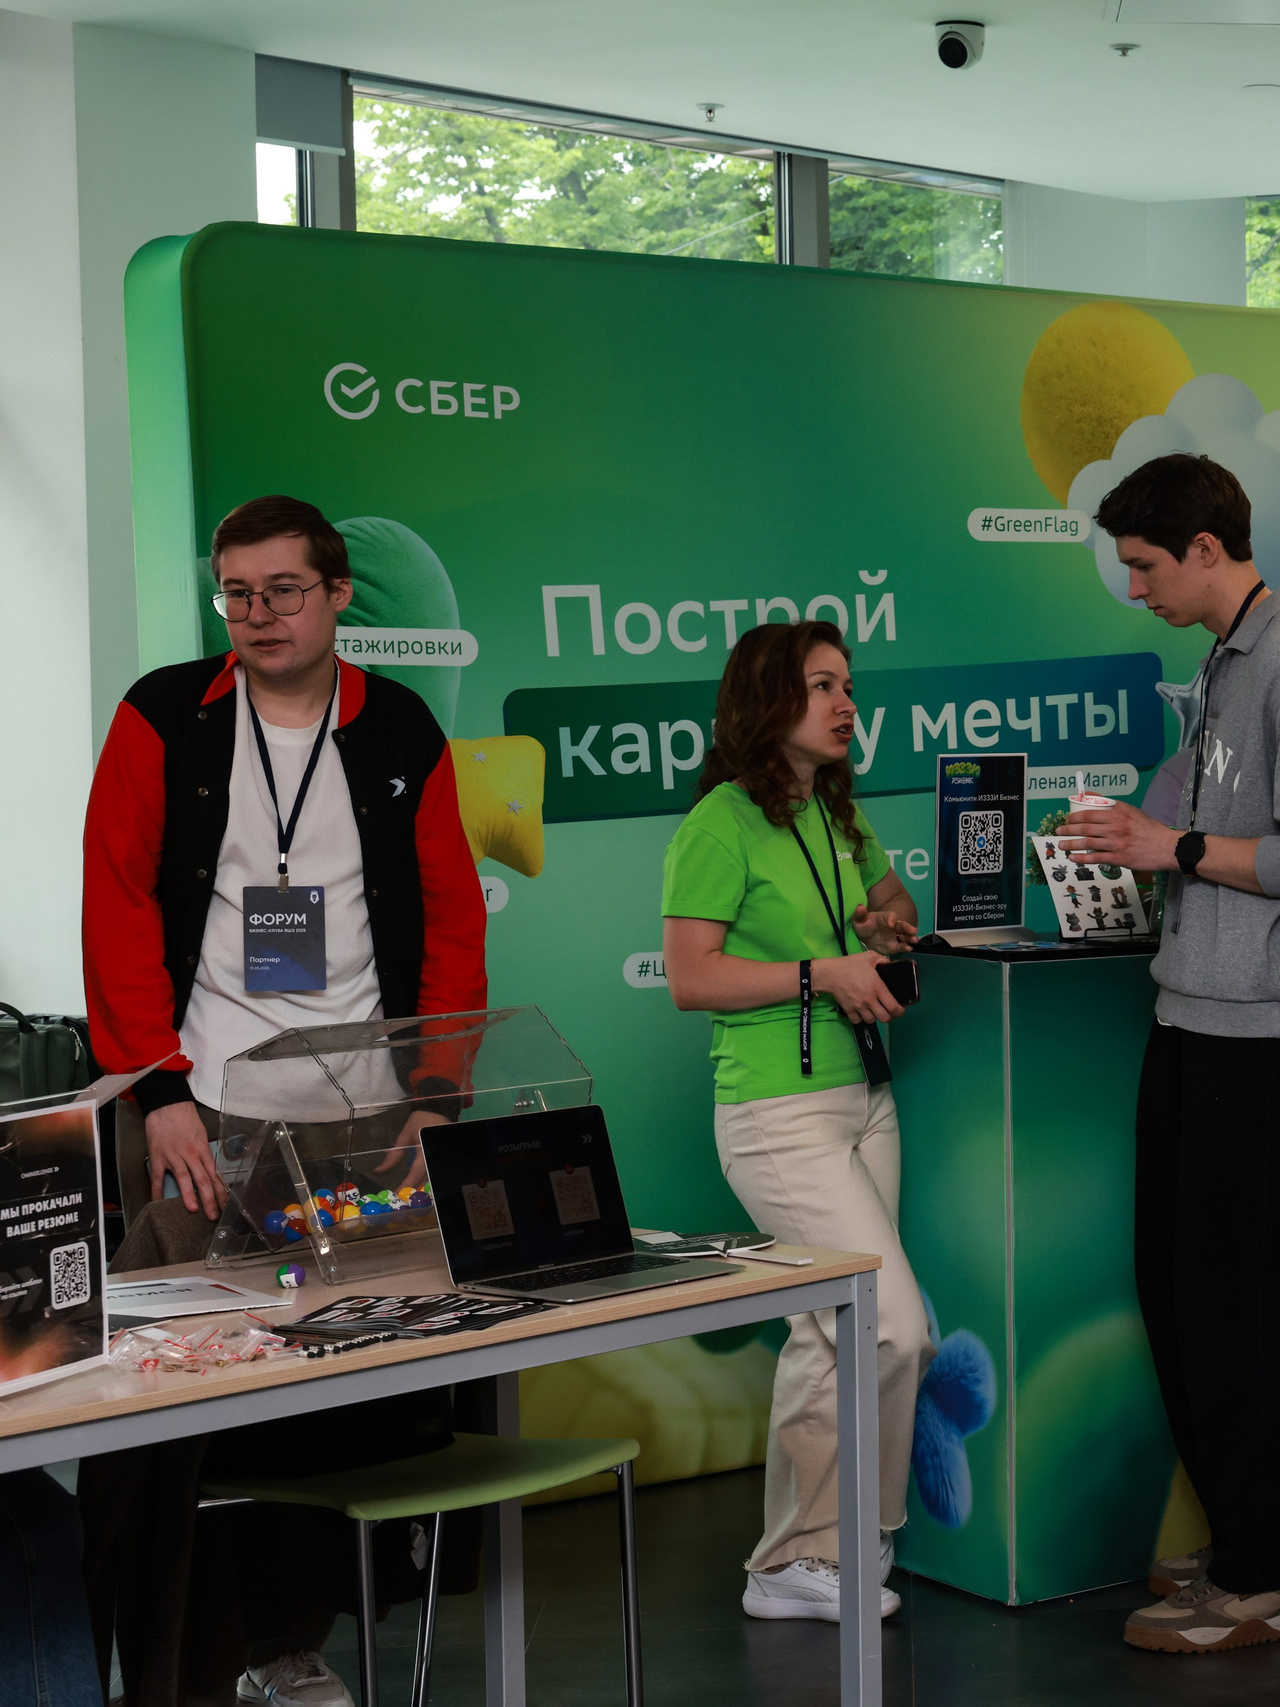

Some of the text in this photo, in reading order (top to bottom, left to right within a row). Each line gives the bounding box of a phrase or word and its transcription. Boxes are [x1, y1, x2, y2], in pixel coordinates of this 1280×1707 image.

[395, 378, 521, 420] СБЕР
[981, 515, 1079, 537] #GreenFlag
[558, 689, 1129, 790] кару мечты
[944, 795, 977, 803] Комьюнити
[1000, 793, 1019, 801] Бизнес
[962, 893, 983, 902] Создай
[249, 913, 306, 926] ФОРУМ
[954, 914, 975, 922] вместе
[983, 912, 1004, 920] Сбером
[0, 1192, 82, 1220] МЫ ПРОКАЧАЛИ
[6, 1211, 79, 1237] ВАШЕ РЕЗЮМЕ
